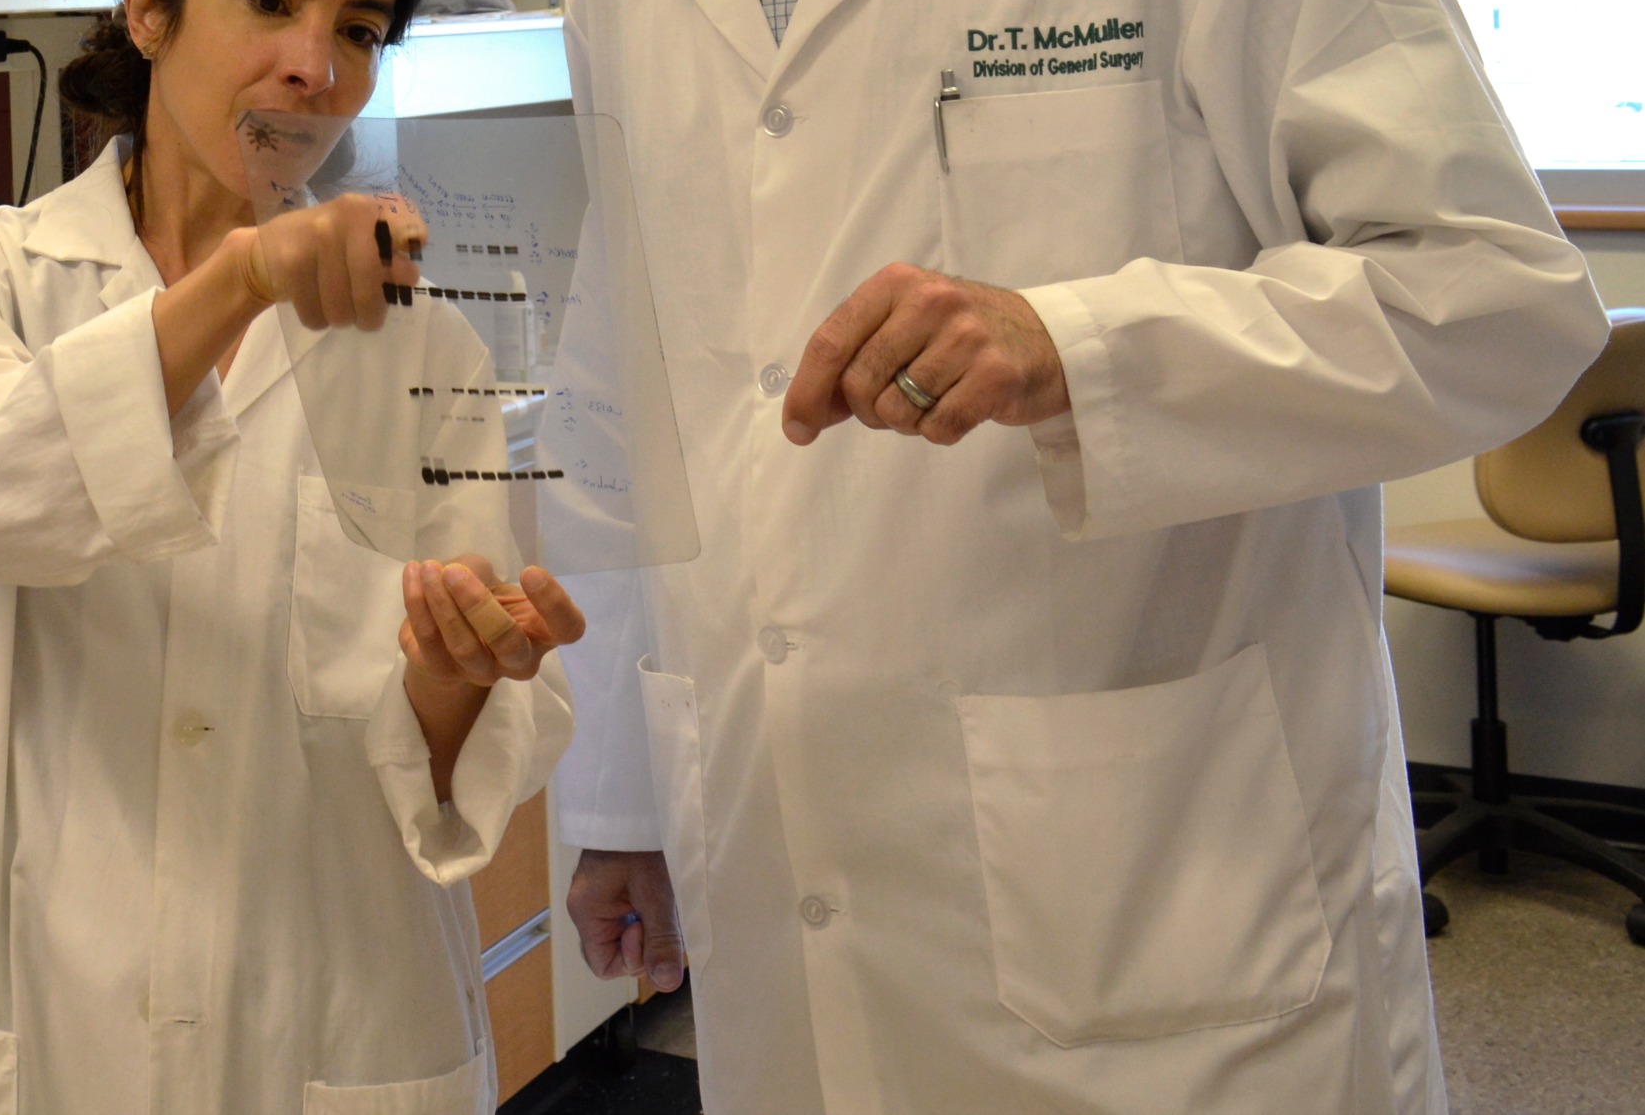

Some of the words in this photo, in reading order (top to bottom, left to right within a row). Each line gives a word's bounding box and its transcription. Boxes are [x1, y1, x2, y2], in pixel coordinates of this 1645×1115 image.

[1033, 18, 1144, 50] McMullen
[973, 59, 1026, 77] Division
[1030, 58, 1044, 75] of
[1048, 53, 1097, 74] General
